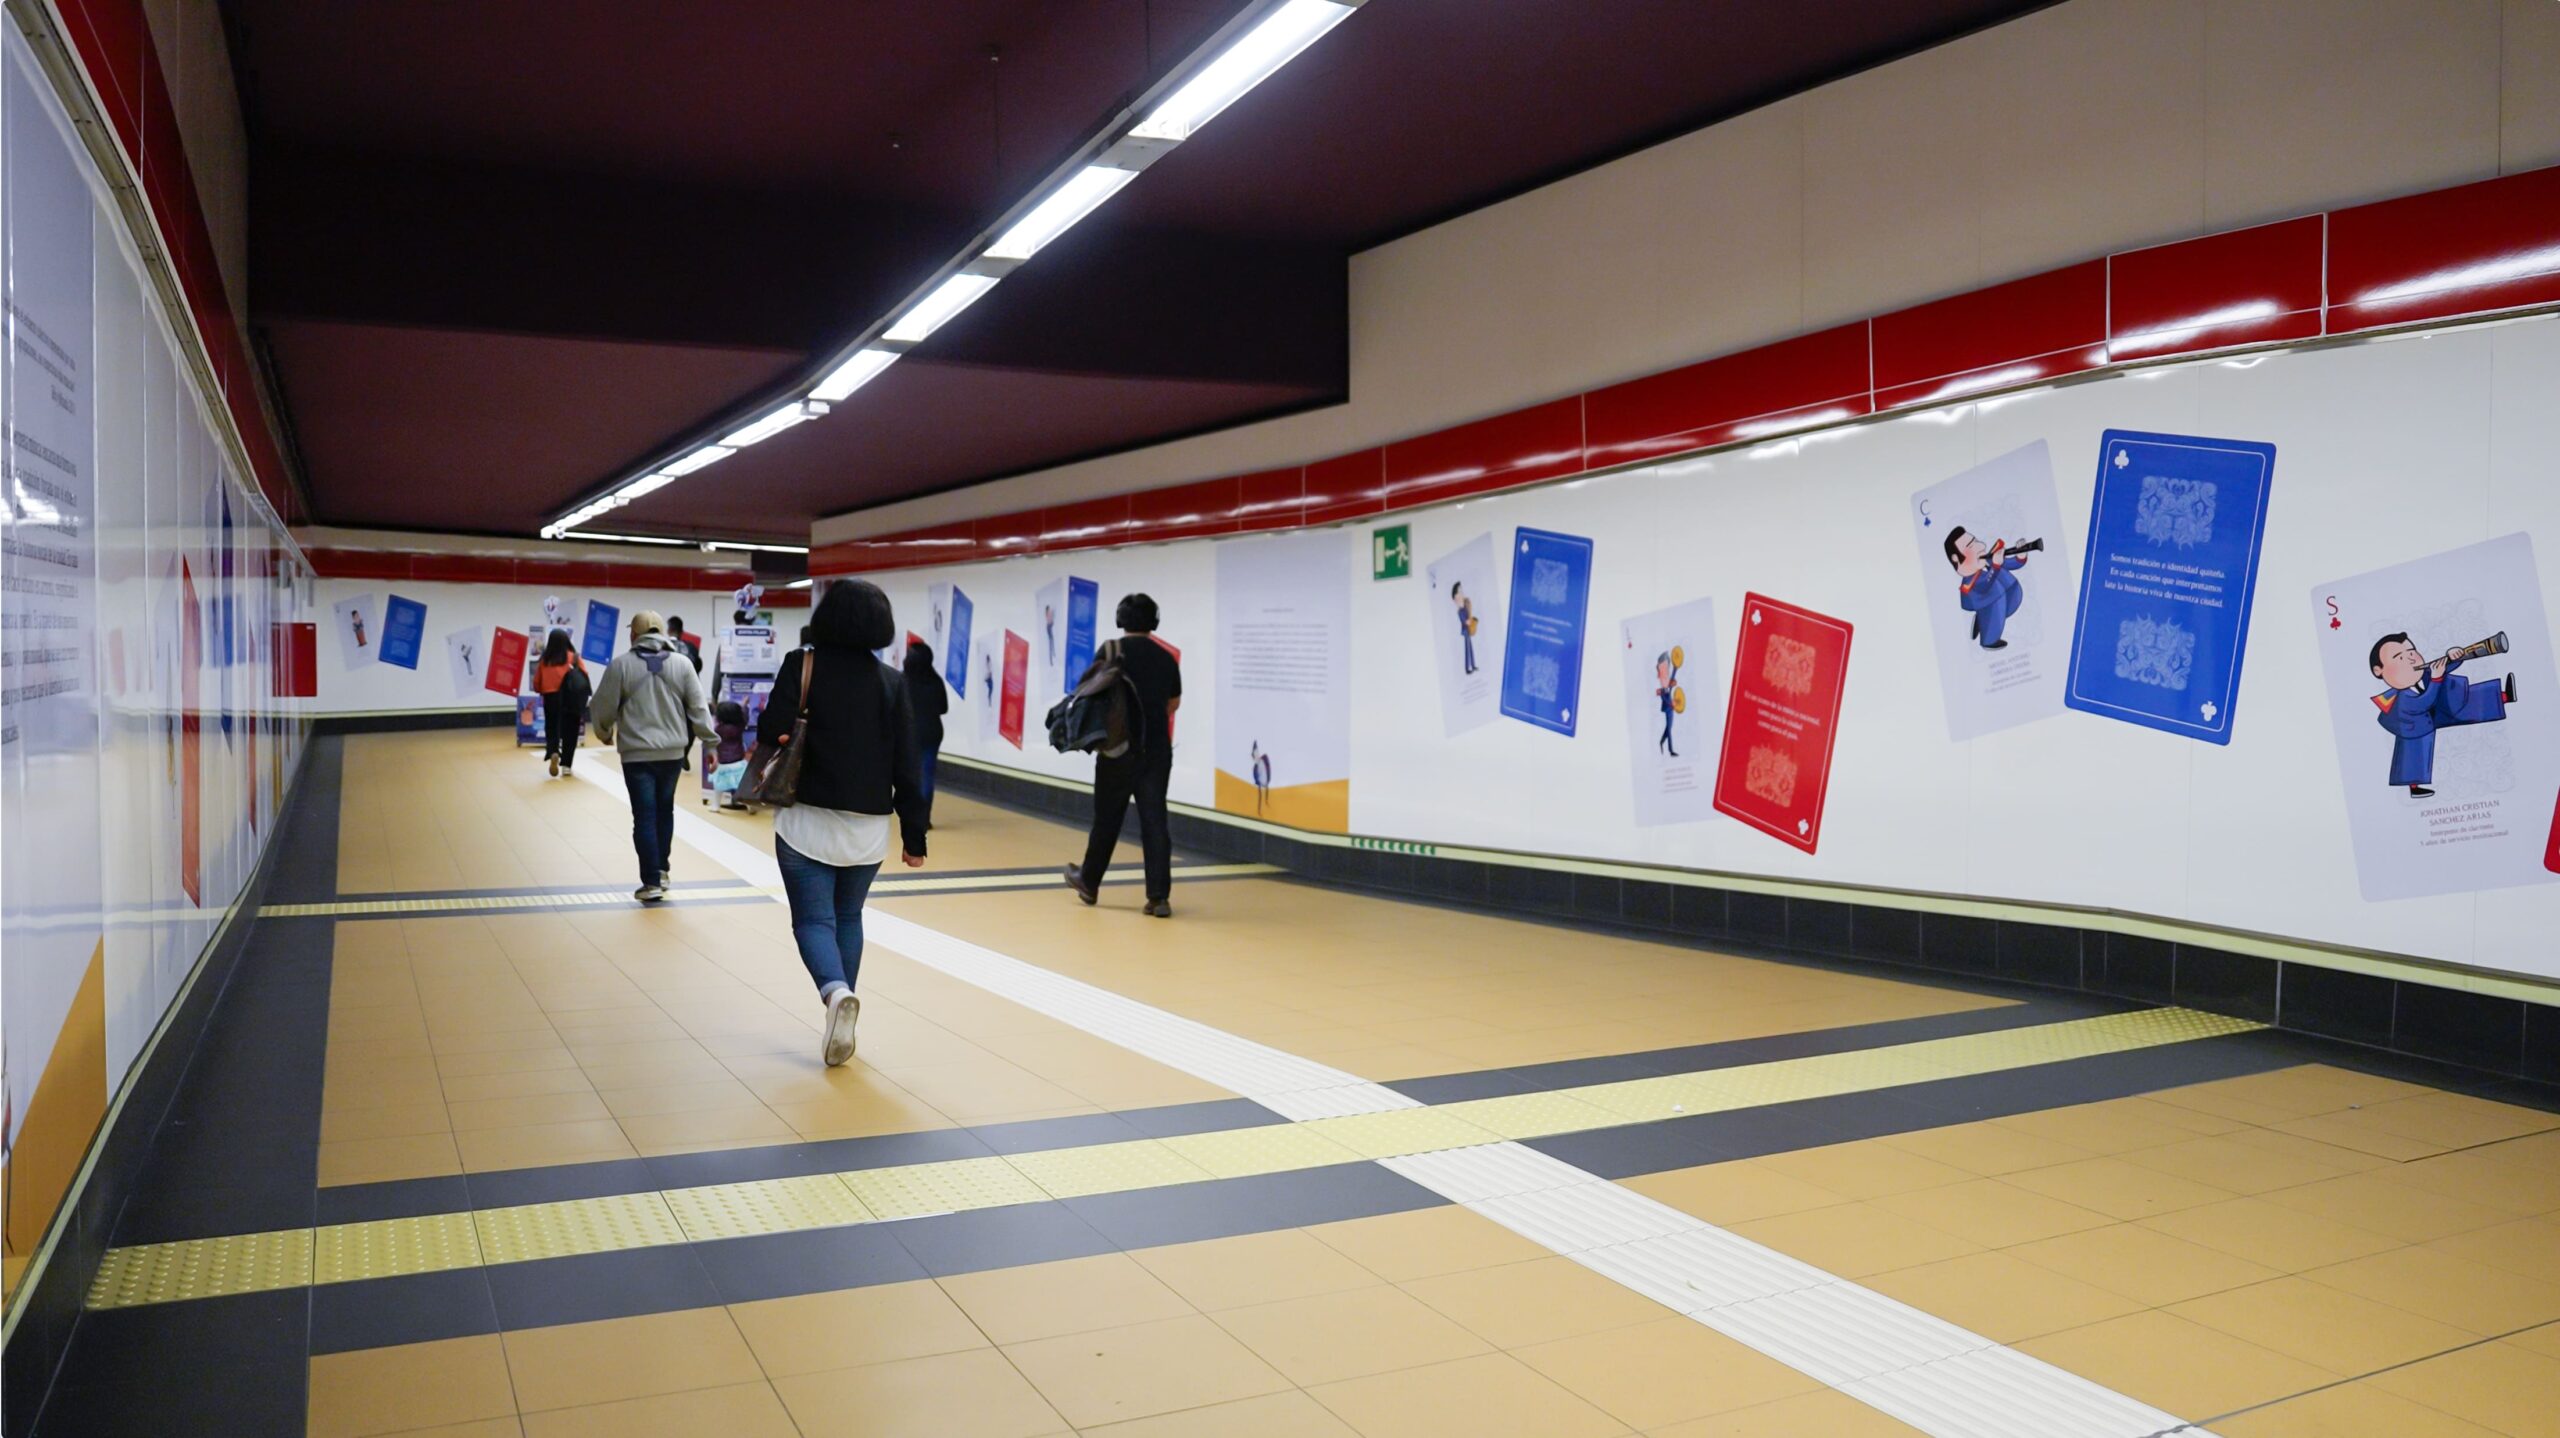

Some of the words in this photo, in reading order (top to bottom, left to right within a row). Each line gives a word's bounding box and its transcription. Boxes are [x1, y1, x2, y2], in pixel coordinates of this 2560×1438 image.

[1920, 499, 1931, 516] C
[2111, 553, 2131, 563] Somos
[2132, 557, 2160, 568] tradición
[2167, 562, 2199, 574] identidad
[2110, 567, 2119, 576] En
[2120, 569, 2135, 578] cada
[2136, 572, 2161, 582] canción
[2162, 576, 2175, 586] que
[2176, 577, 2222, 593] interpretamos
[2104, 580, 2116, 589] late
[2118, 582, 2124, 590] la
[2124, 583, 2148, 595] historia
[2150, 588, 2163, 598] viva
[2164, 590, 2173, 600] de
[2174, 593, 2199, 604] nuestra
[2326, 596, 2339, 616] S
[2420, 804, 2460, 818] JONATHAN
[2461, 800, 2500, 812] CRISTIAN
[2466, 810, 2492, 821] ARIAS
